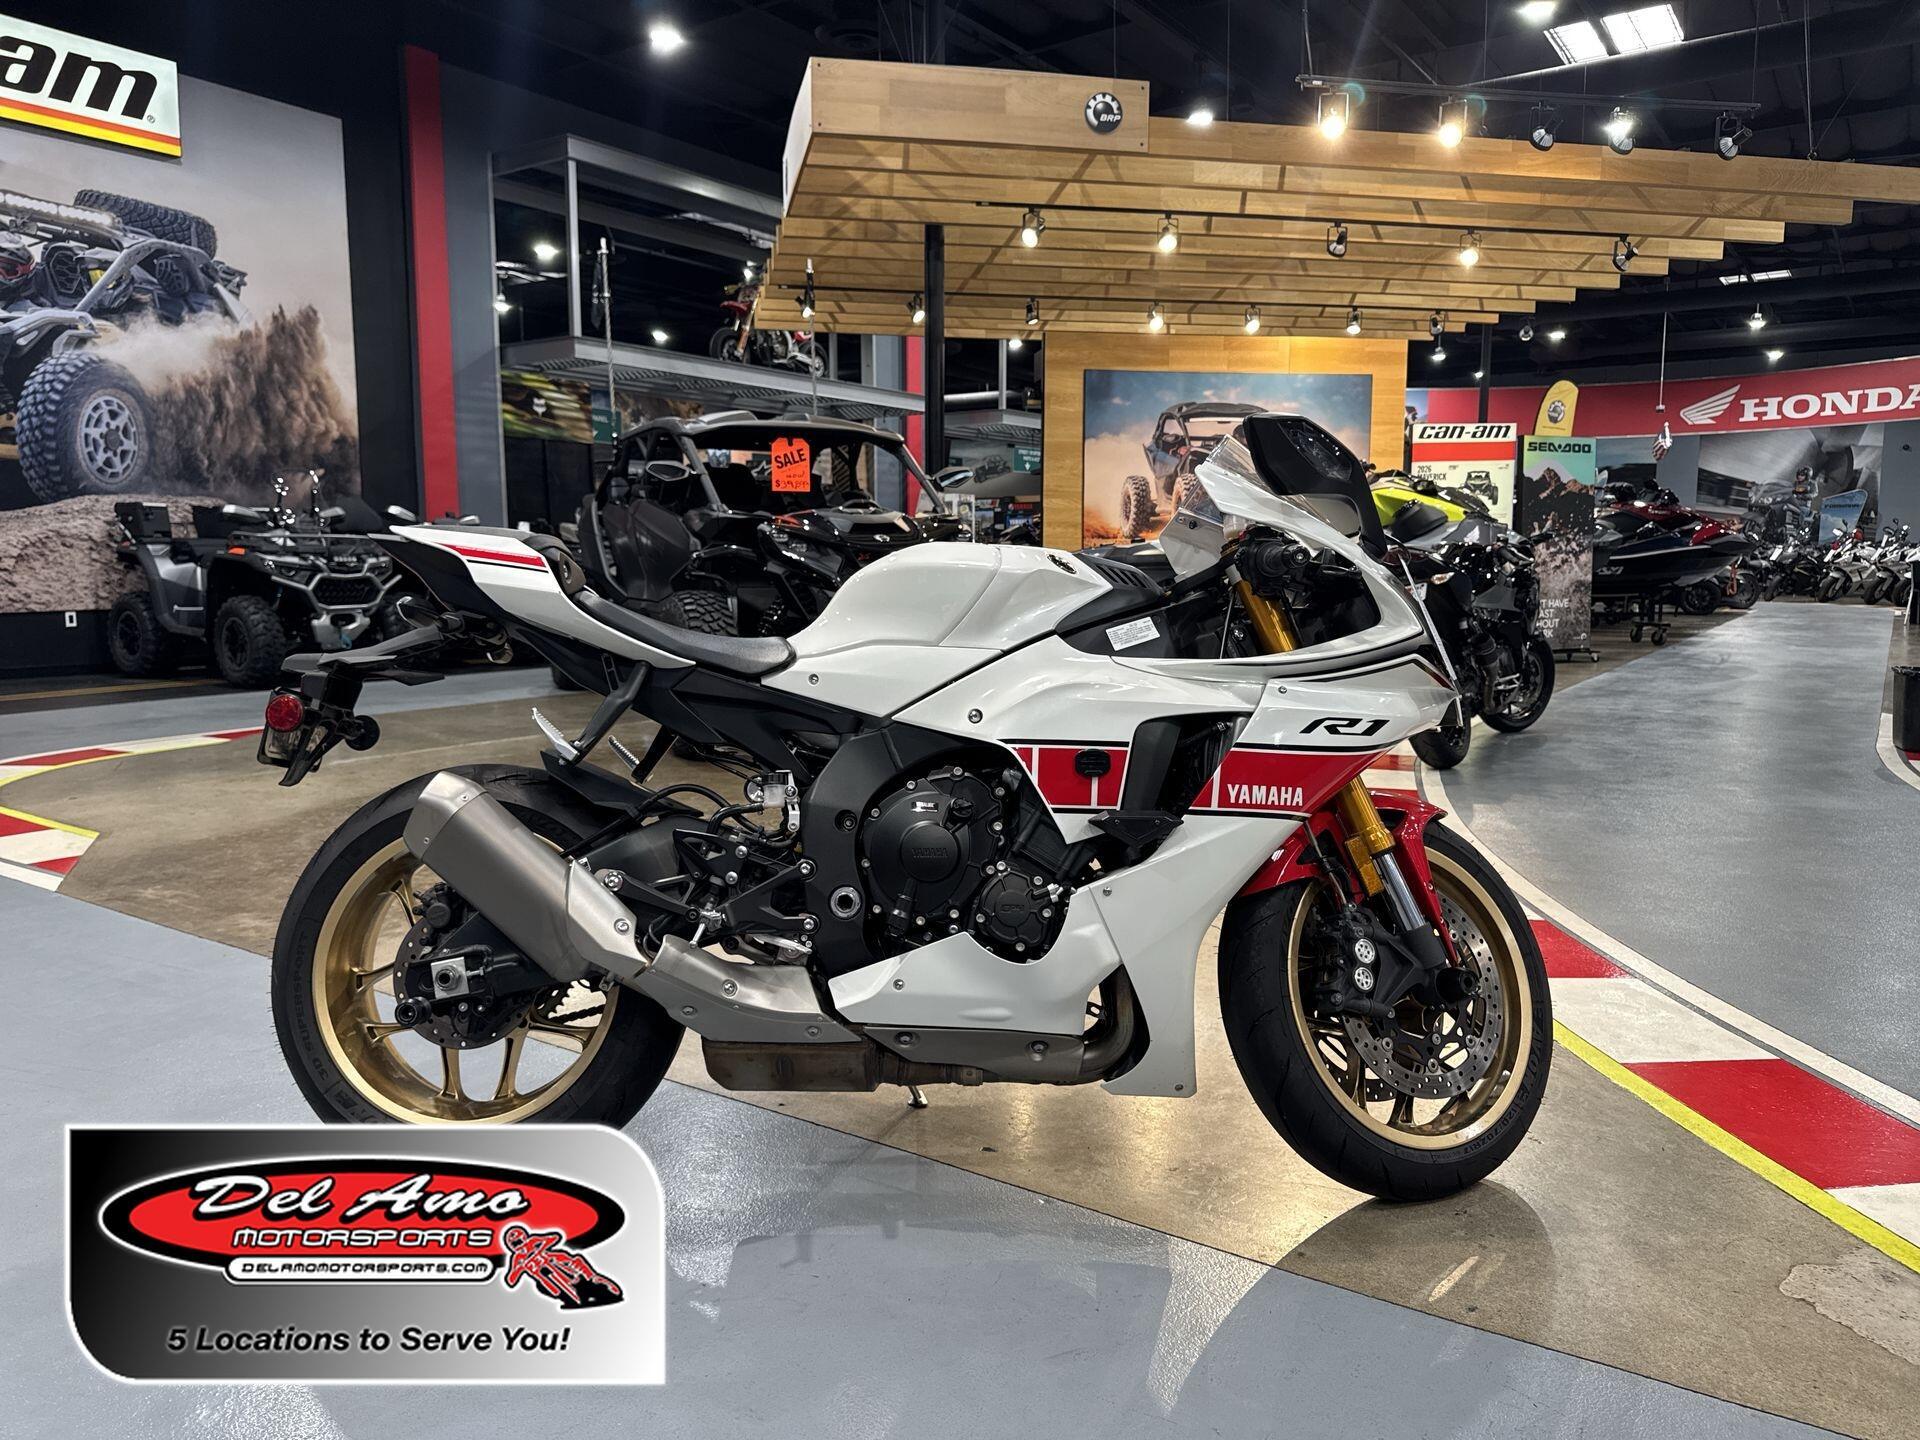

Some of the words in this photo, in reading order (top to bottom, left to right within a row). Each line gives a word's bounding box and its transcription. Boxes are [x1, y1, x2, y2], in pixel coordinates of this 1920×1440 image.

[1100, 113, 1122, 122] BRP
[1418, 424, 1511, 439] can-am
[774, 448, 807, 469] SALE
[1417, 465, 1432, 473] 2026
[1549, 599, 1569, 608] HAVE
[1539, 609, 1554, 618] AST
[1536, 619, 1560, 628] HOUT
[1299, 717, 1390, 736] R1
[1227, 784, 1303, 806] YAMAHA
